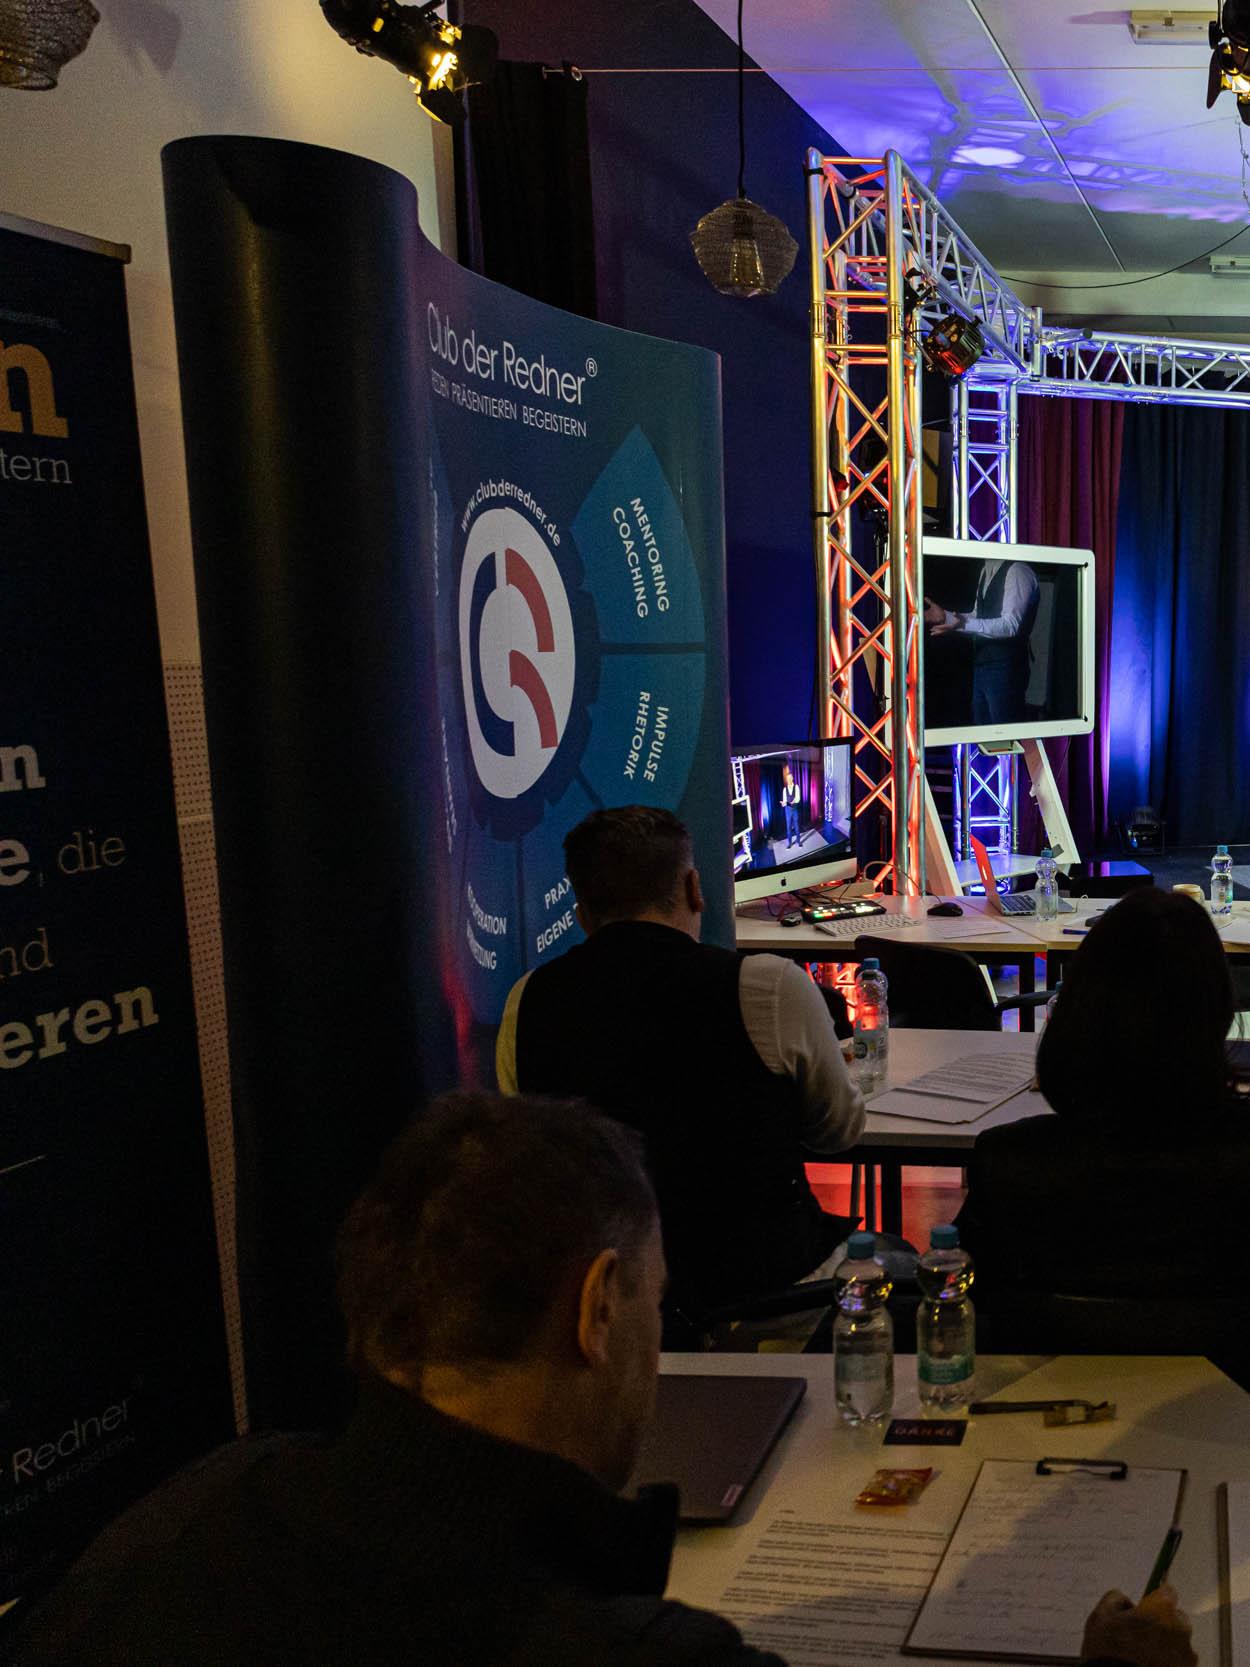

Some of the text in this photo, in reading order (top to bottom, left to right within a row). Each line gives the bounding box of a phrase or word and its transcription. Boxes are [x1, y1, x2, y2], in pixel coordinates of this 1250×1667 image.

[462, 329, 500, 381] der
[451, 382, 518, 420] PRÄSENTIEREN
[522, 405, 587, 438] BEGEISTERN
[460, 478, 561, 547] www.clubderredner.de
[612, 506, 649, 619] COACHING
[630, 497, 670, 613] MENTORING
[624, 690, 651, 781] RHETORIK
[643, 705, 670, 783] IMPULSE
[57, 827, 129, 875] die
[536, 910, 574, 953] EIGENE
